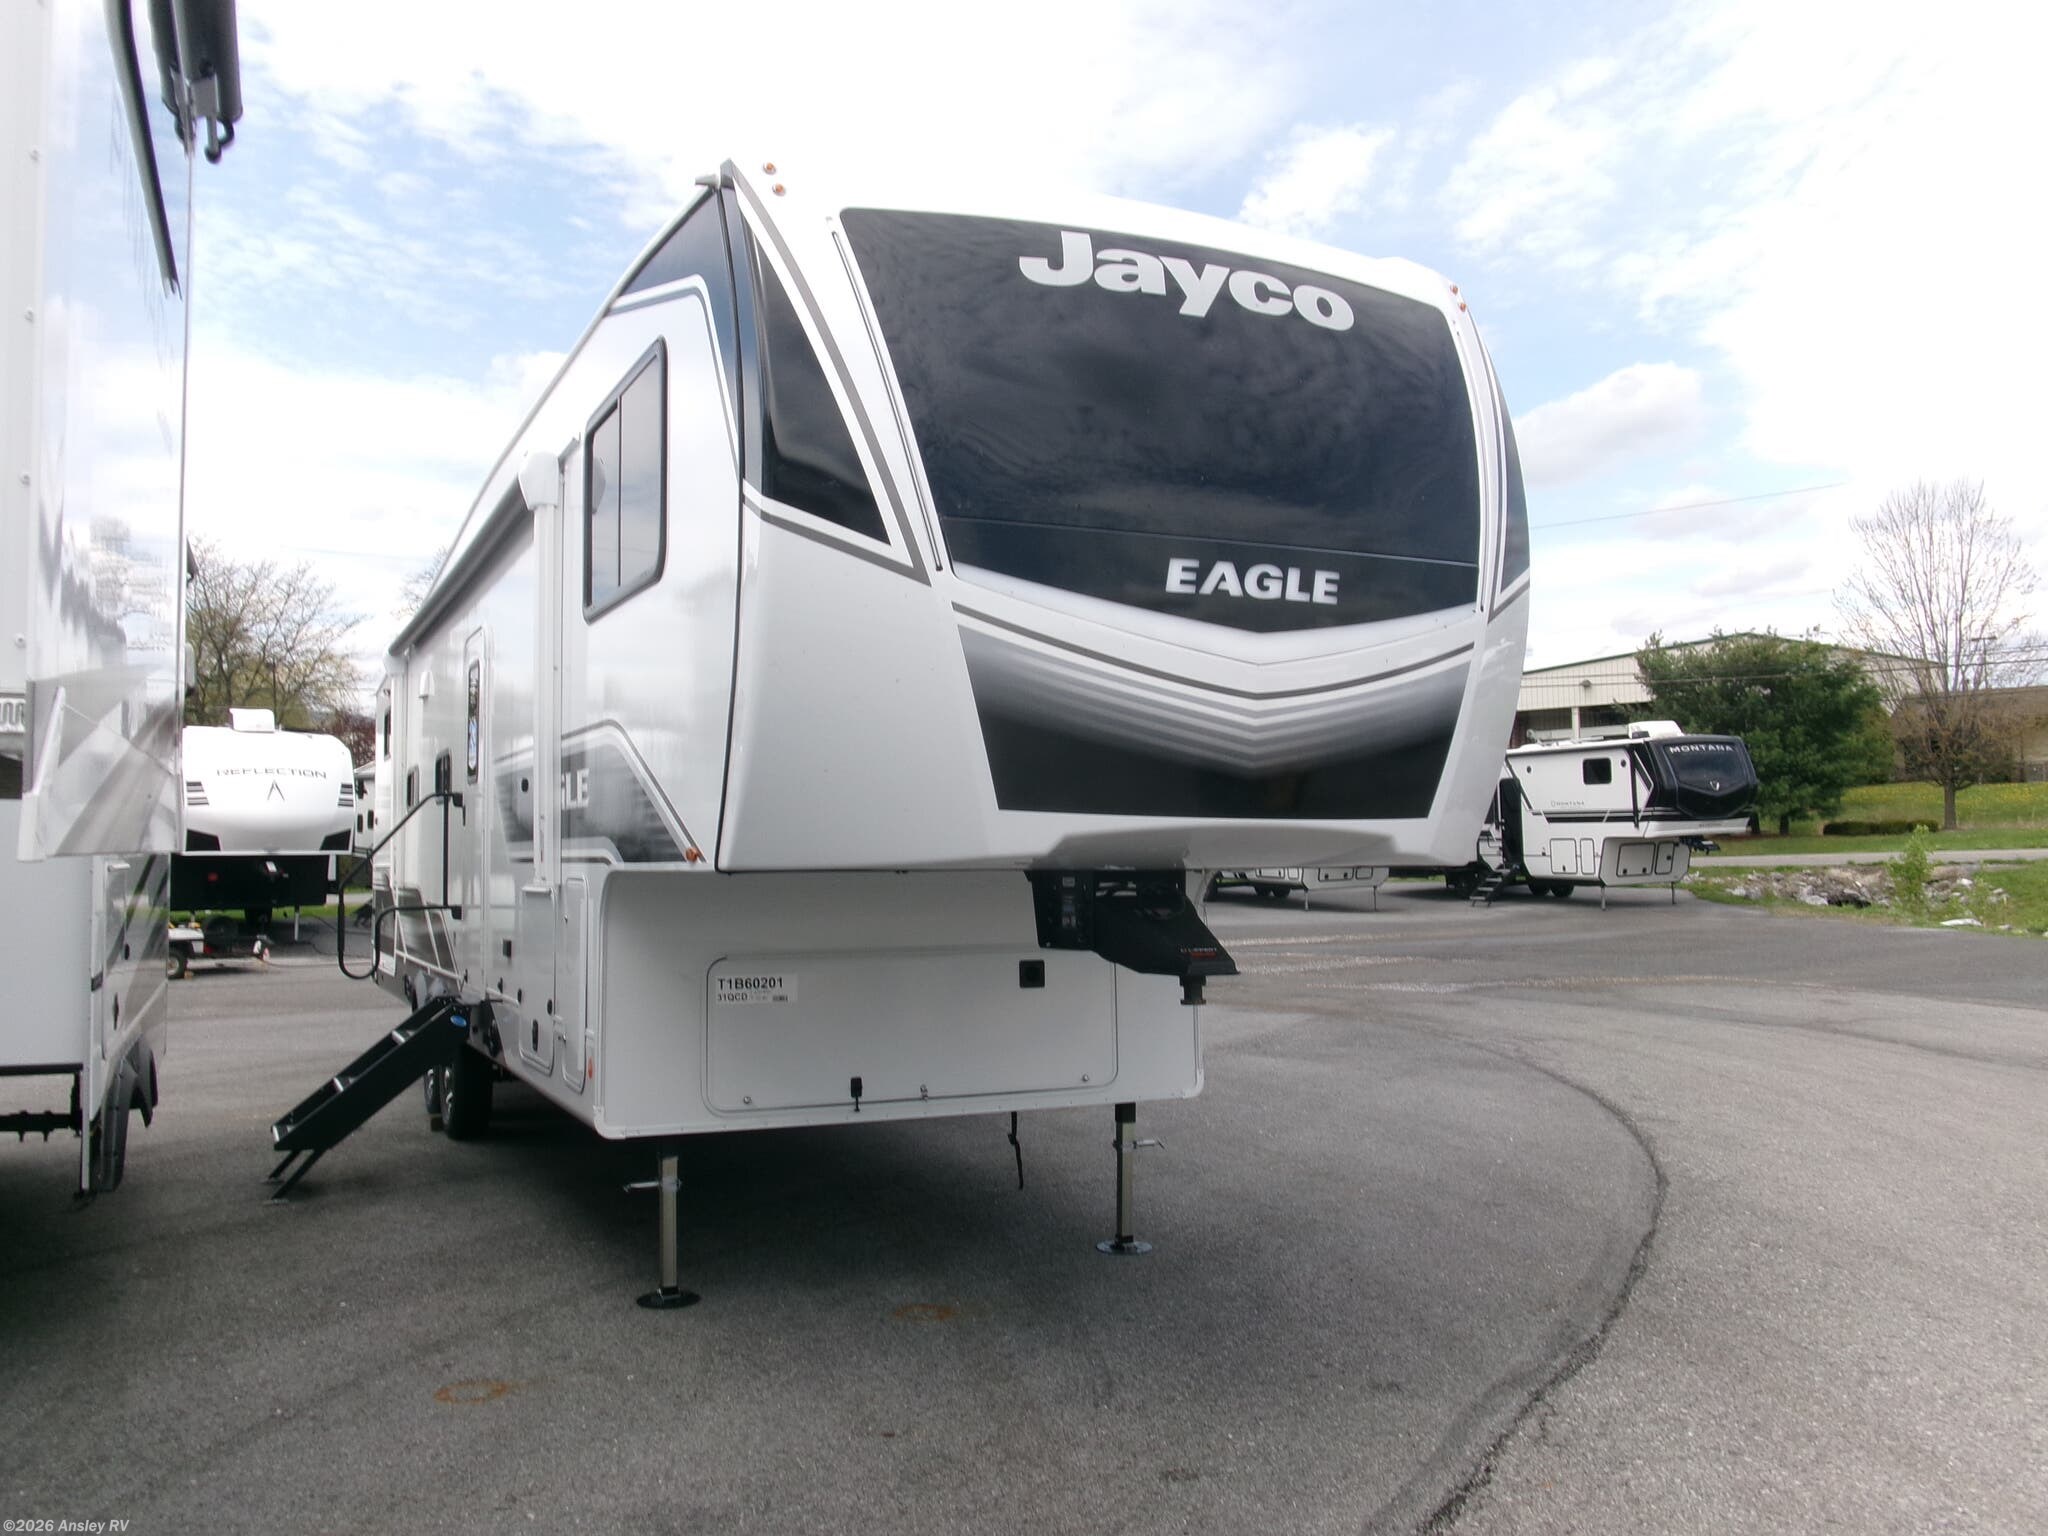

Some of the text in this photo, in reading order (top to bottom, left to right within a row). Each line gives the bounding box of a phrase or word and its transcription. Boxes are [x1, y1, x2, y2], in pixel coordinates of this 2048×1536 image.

[1018, 230, 1355, 332] Jayco
[1165, 557, 1341, 605] EAGLE
[1669, 744, 1734, 755] MONTANA
[216, 767, 328, 780] REFLECTION
[717, 976, 783, 991] T1B60201
